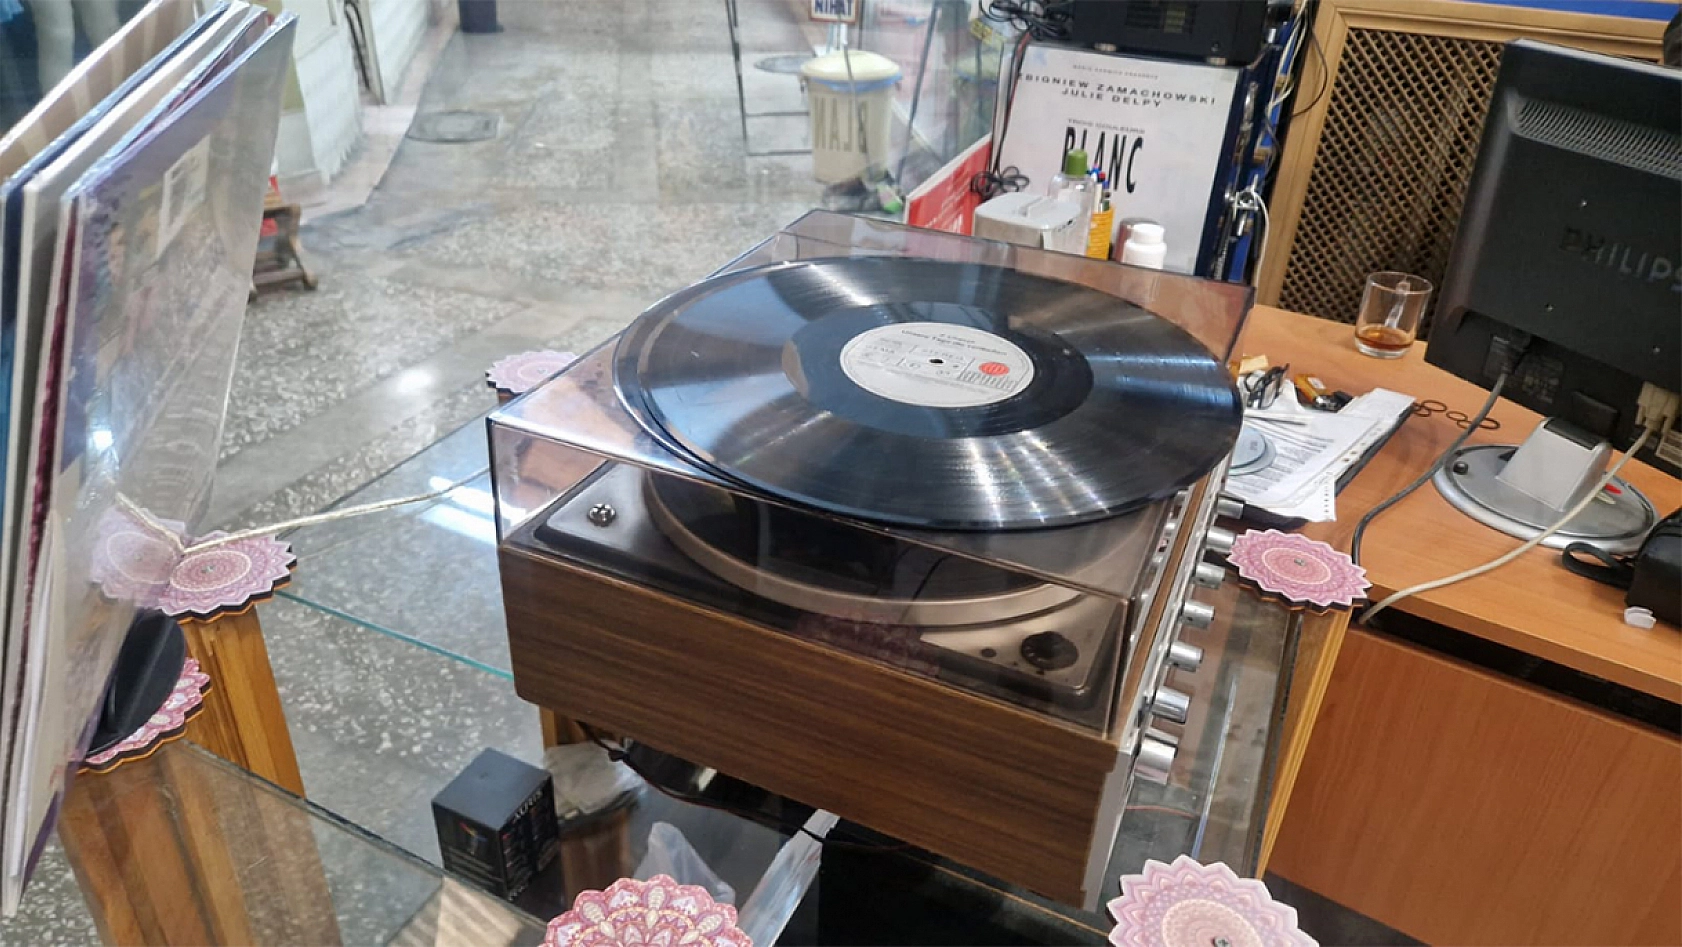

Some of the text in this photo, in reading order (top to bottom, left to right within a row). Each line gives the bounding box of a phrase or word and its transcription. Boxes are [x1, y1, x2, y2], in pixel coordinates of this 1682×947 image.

[1061, 88, 1162, 108] JULIE DELPY
[1096, 83, 1216, 106] ZAMACHOWSKI
